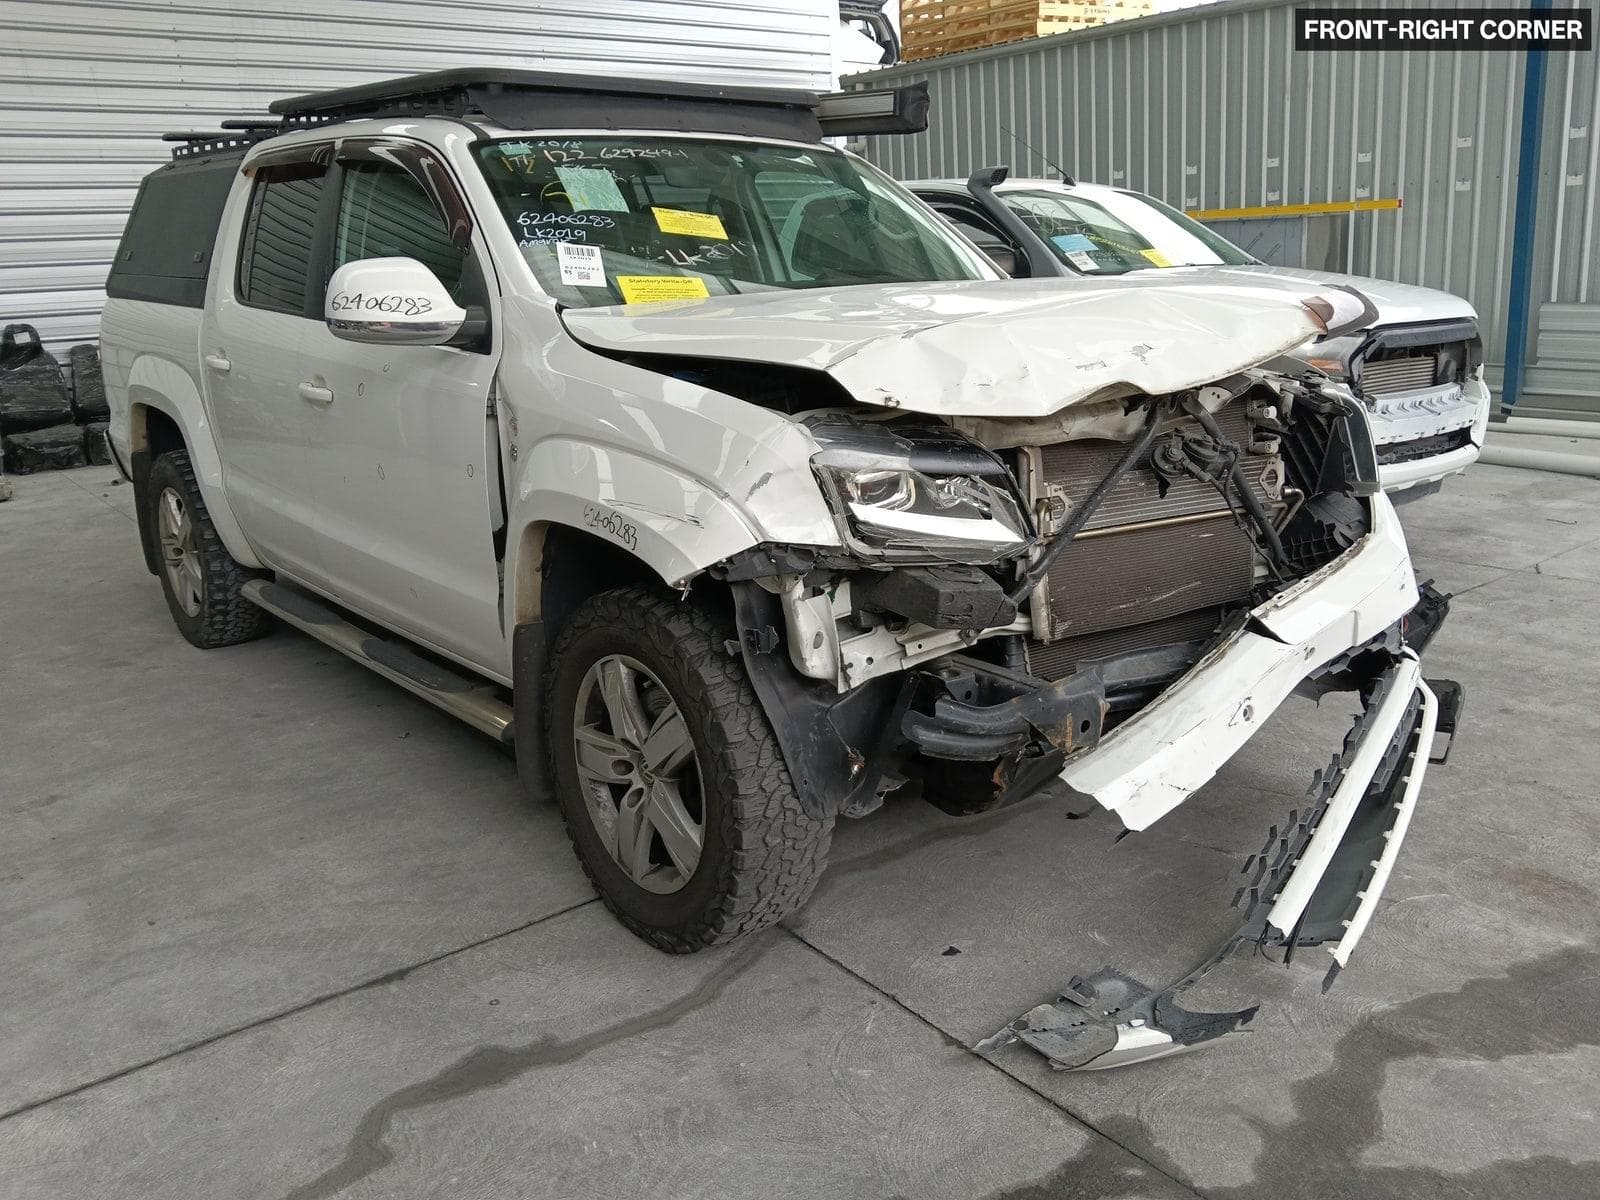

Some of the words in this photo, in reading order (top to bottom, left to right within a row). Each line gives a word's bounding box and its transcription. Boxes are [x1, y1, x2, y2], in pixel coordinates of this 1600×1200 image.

[516, 211, 616, 229] 62406283
[523, 226, 586, 241] LK2019
[331, 291, 433, 316] 62406283
[583, 503, 638, 551] 62406283
